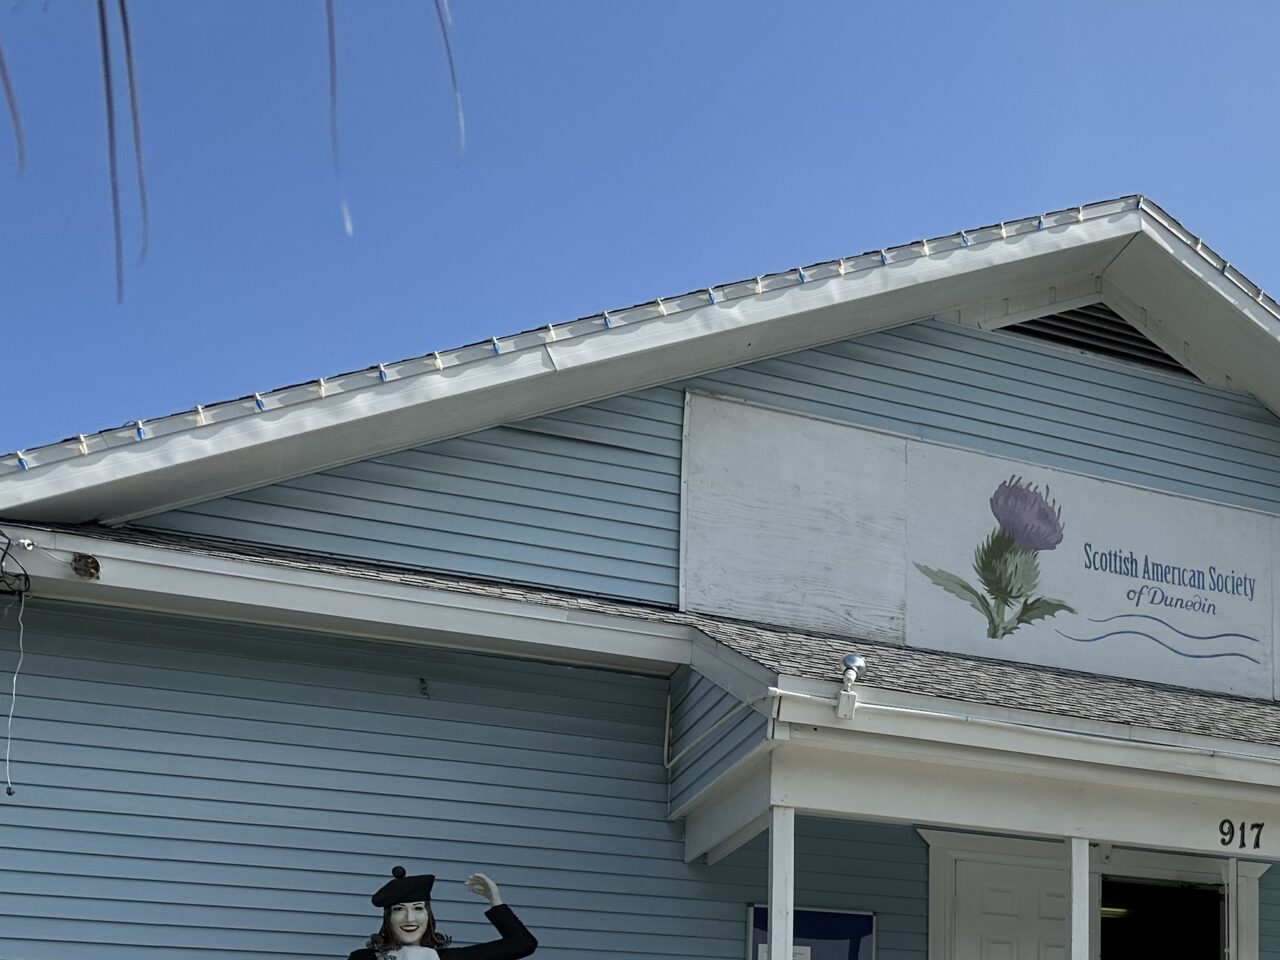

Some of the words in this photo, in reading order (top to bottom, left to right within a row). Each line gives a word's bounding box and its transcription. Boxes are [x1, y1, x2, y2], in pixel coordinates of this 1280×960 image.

[1084, 543, 1138, 578] Scottish
[1142, 554, 1205, 590] American
[1208, 566, 1256, 601] Society
[1126, 585, 1149, 607] of
[1148, 587, 1216, 615] Dunedin
[1219, 818, 1265, 849] 917
